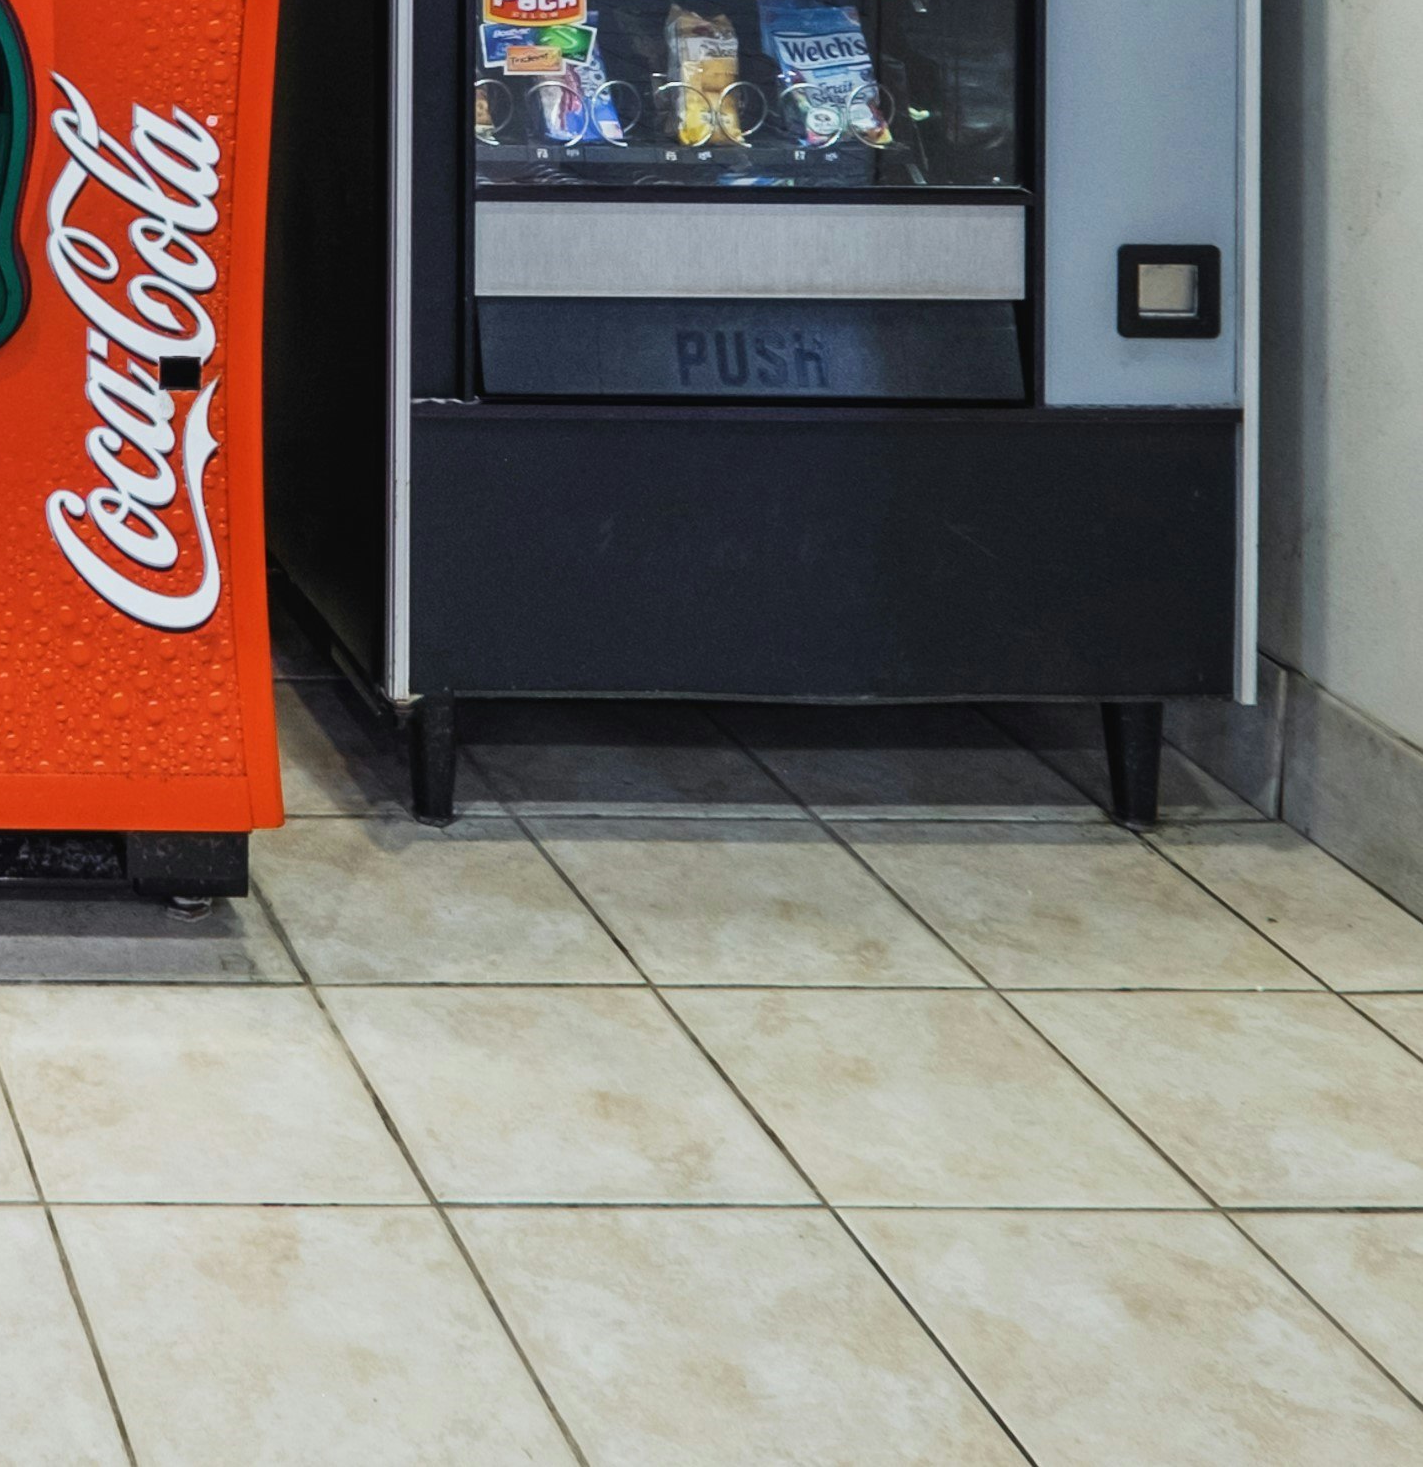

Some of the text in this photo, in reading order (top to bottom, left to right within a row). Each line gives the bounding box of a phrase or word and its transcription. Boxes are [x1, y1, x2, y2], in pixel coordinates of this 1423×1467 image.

[781, 35, 867, 63] Welch's
[46, 69, 221, 633] Coca-Cola
[676, 330, 830, 387] PUSH
